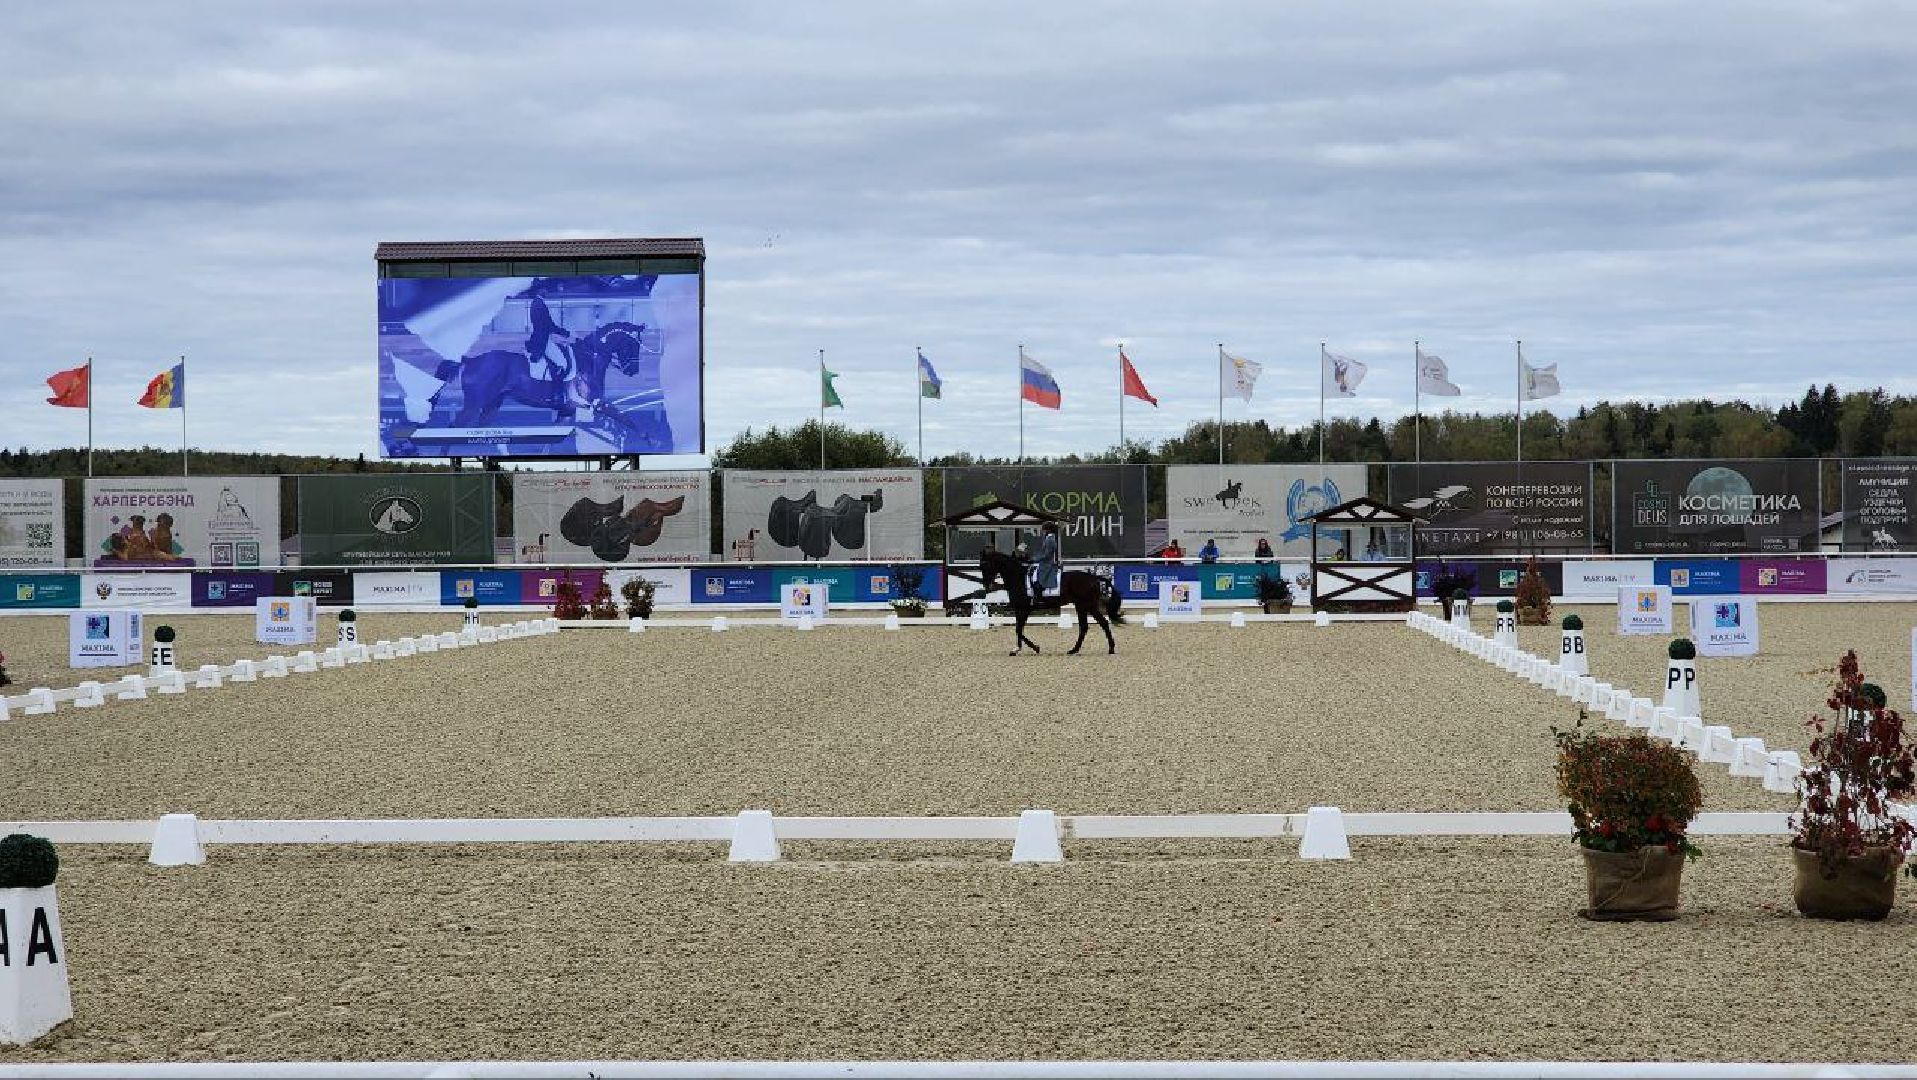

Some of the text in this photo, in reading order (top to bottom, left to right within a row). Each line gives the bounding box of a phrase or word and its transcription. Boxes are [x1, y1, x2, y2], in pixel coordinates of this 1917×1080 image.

[1486, 485, 1582, 496] КОНЕПЕРЕВОЗКИ
[93, 495, 194, 507] ХАРПЕРСБЭНД
[1026, 492, 1121, 513] КОРМА
[1486, 496, 1584, 508] ПО ВСЕЙ РОССИИ
[1637, 499, 1667, 509] COSMO
[1679, 494, 1801, 511] КОСМЕТИКА
[1637, 510, 1667, 524] DEUS
[1679, 511, 1780, 526] ДЛЯ ЛОШАДЕЙ
[1532, 529, 1584, 540] 106-08-65
[1710, 634, 1747, 642] MAXIMA
[81, 644, 115, 652] MAXIMA
[26, 907, 58, 967] A
